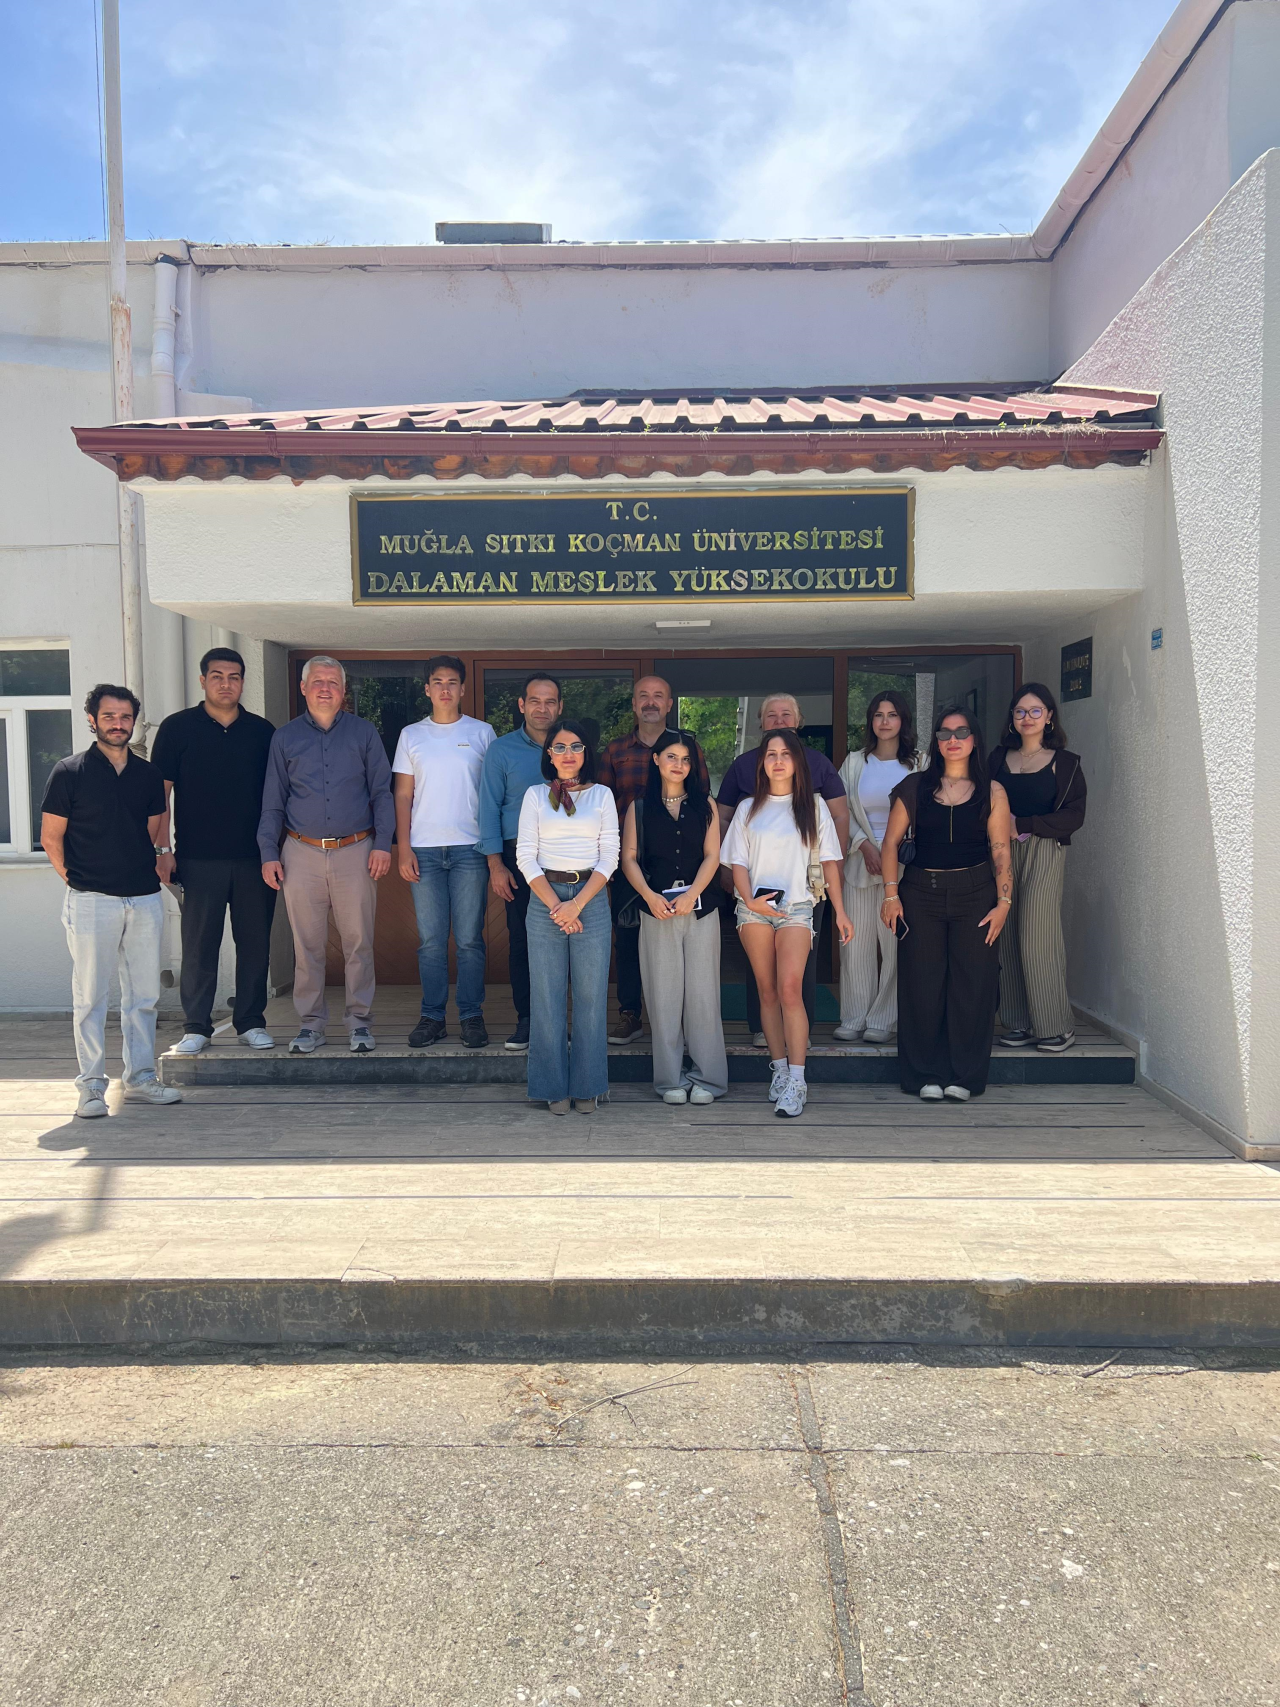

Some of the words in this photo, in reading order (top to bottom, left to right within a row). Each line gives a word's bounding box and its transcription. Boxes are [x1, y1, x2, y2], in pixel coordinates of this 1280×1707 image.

[606, 501, 657, 521] T.C.
[379, 529, 473, 554] MUĞLA
[485, 533, 555, 553] SITKI
[568, 533, 681, 557] KOÇMAN
[692, 525, 884, 551] ÜNİVERSİTESİ
[368, 571, 518, 593] DALAMAN
[530, 570, 657, 593] MESLEK
[669, 566, 897, 591] YÜKSEKOKULU
